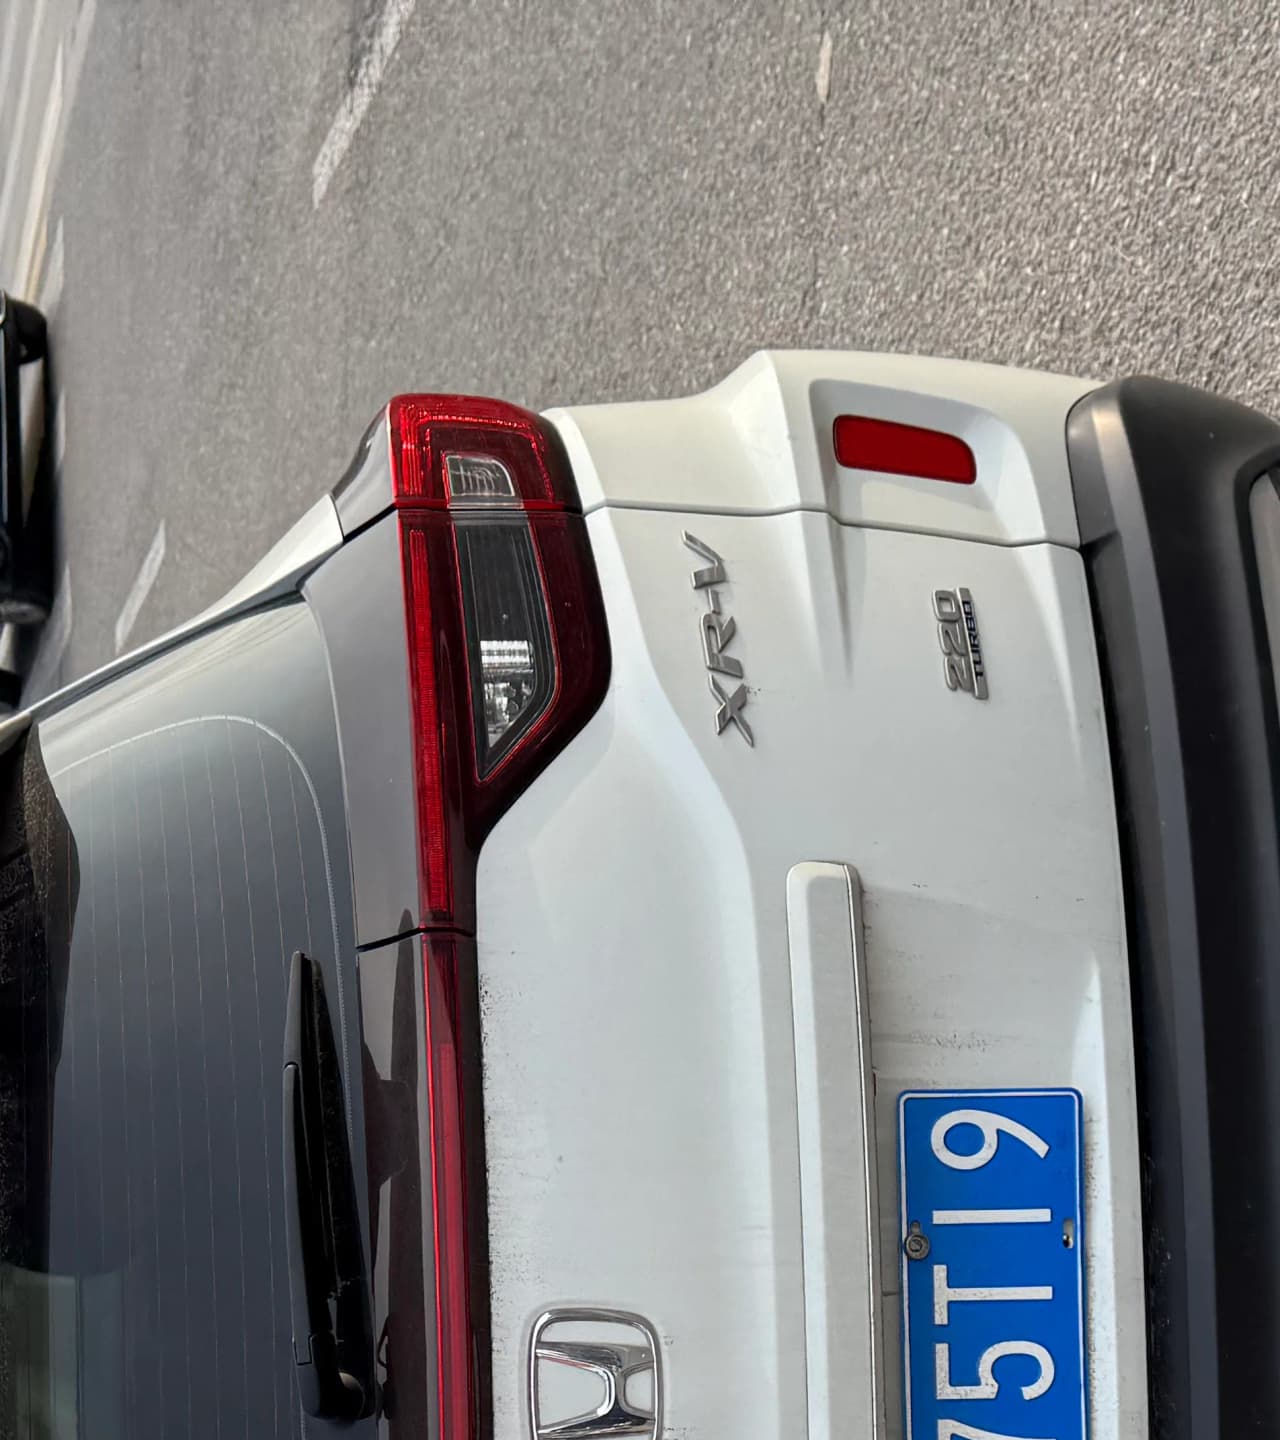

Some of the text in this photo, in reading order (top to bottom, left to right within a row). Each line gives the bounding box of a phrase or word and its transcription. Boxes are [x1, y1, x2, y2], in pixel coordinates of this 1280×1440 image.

[680, 530, 754, 748] XR-V
[932, 589, 974, 692] 220
[961, 600, 984, 680] TURBO
